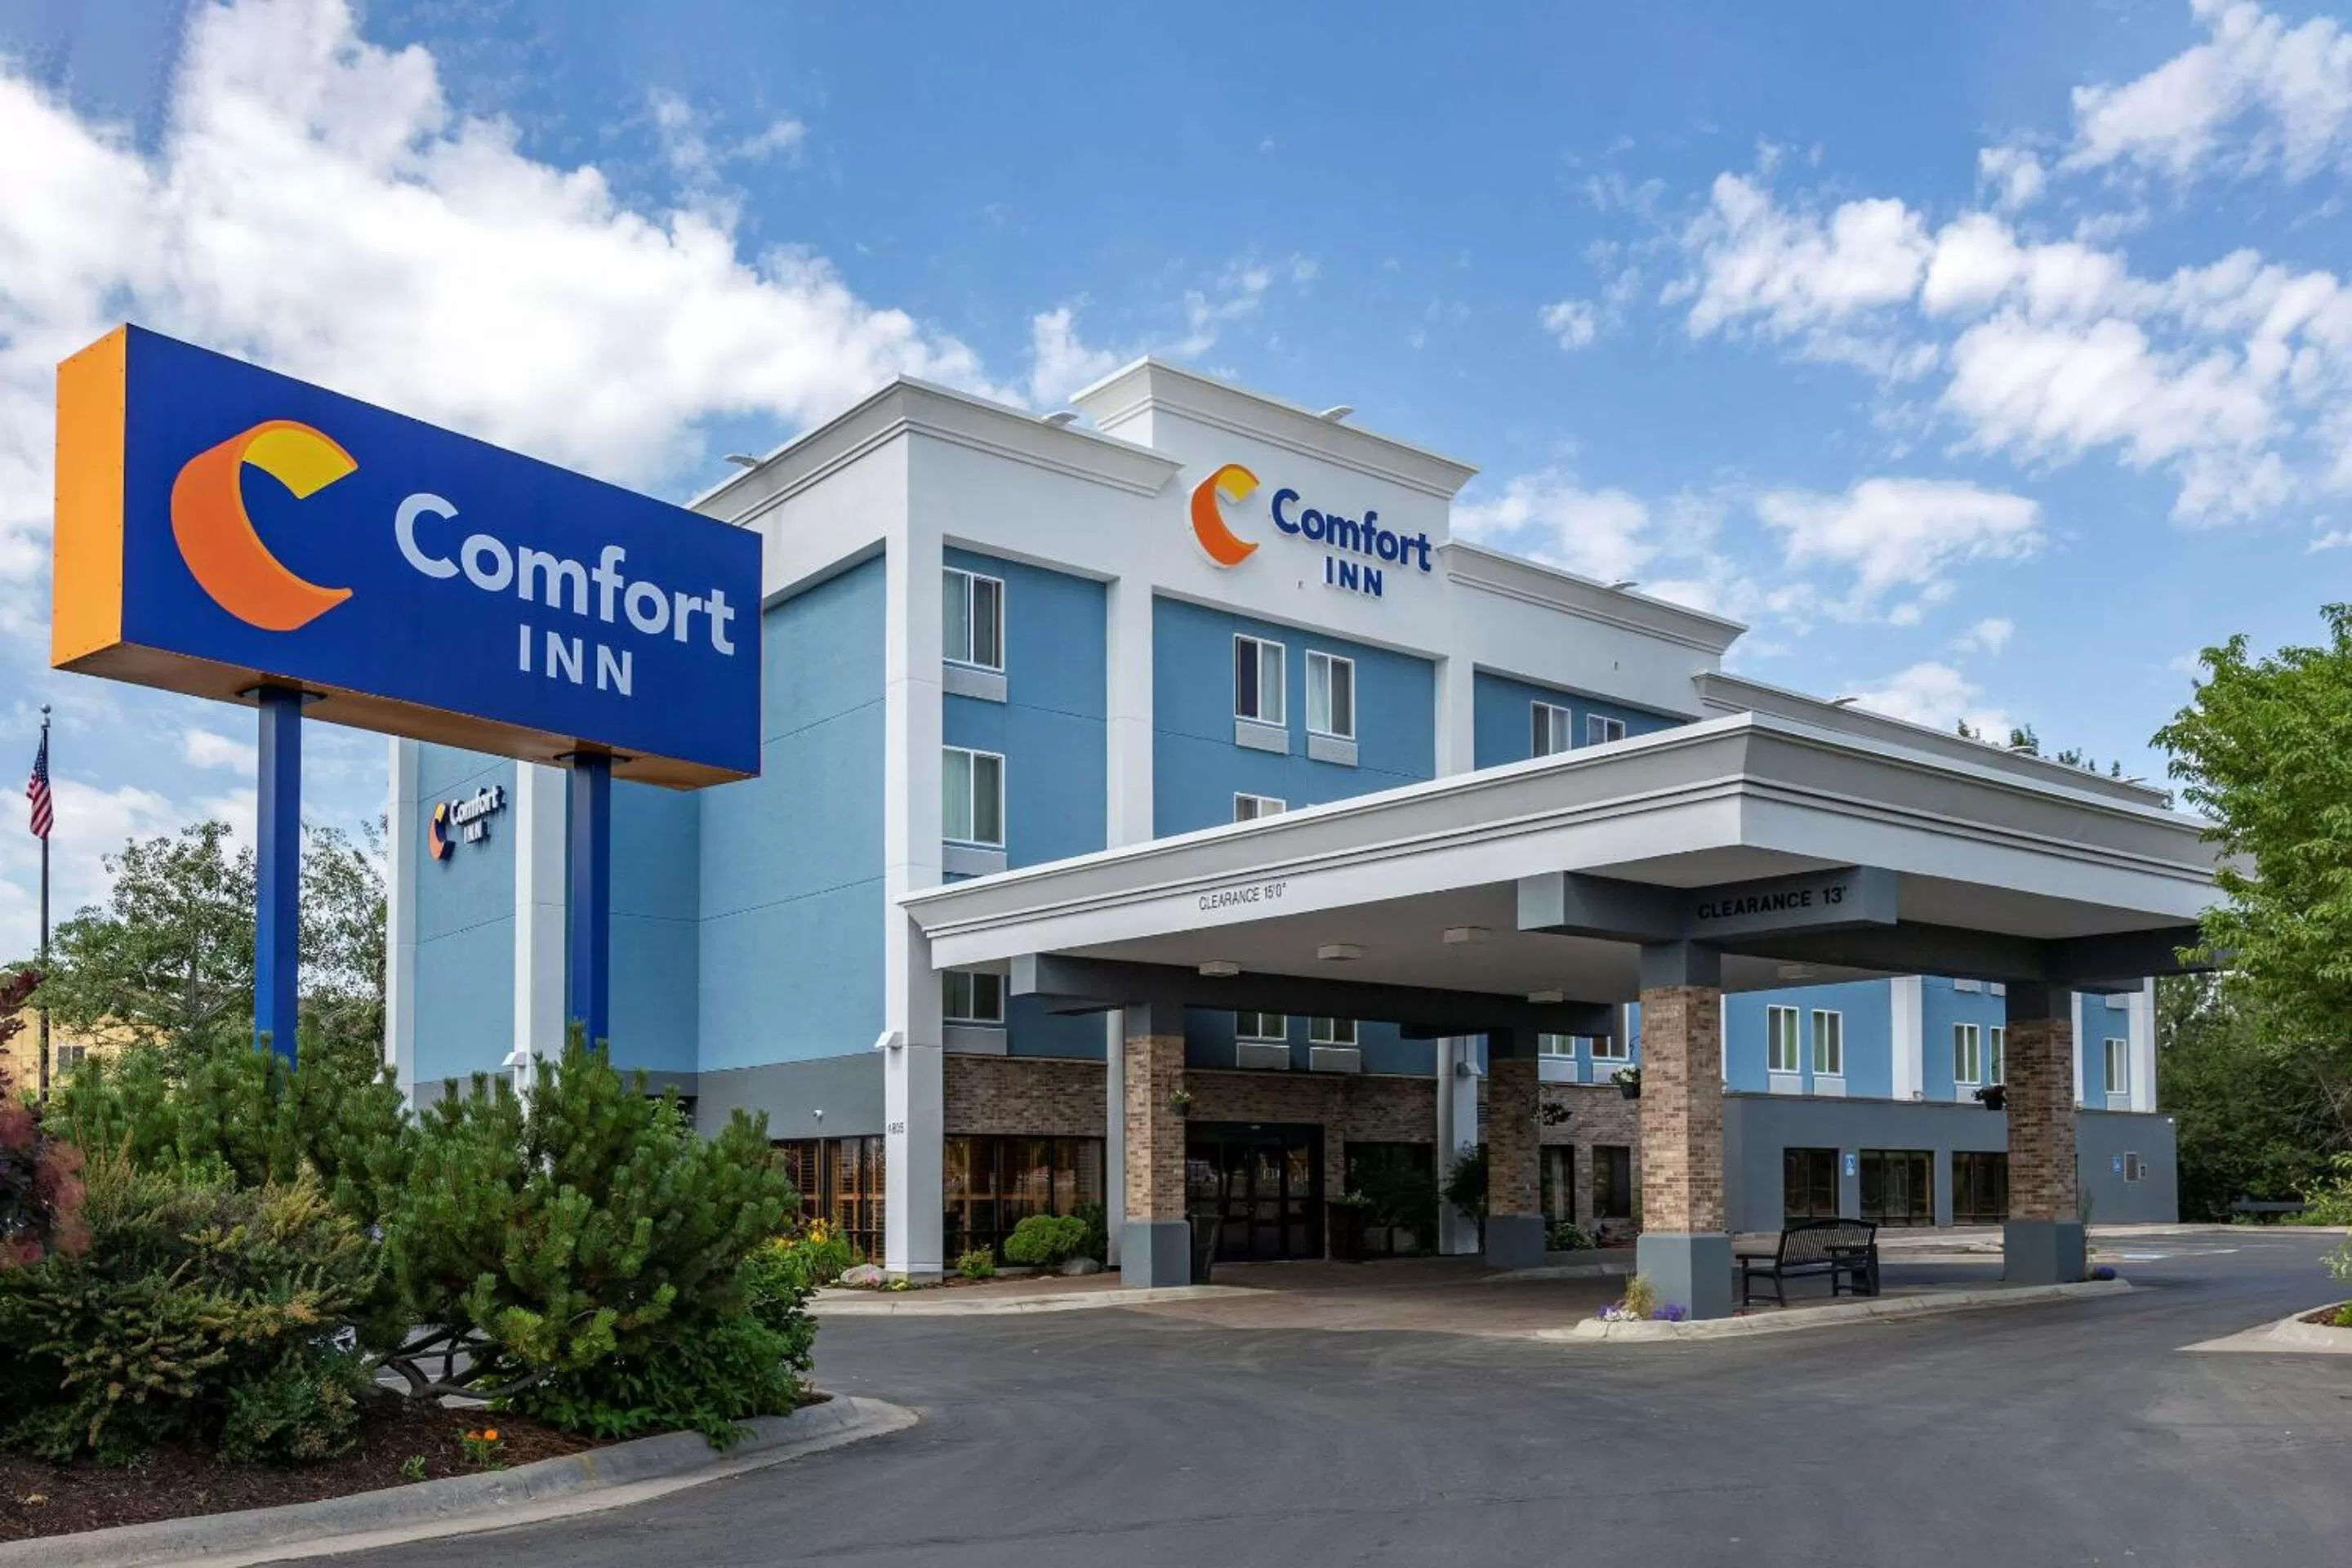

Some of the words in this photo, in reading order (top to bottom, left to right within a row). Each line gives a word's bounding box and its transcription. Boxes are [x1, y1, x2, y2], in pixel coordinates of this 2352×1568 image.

[1272, 488, 1432, 572] Comfort
[394, 492, 734, 656] Comfort
[1326, 556, 1382, 596] INN
[519, 623, 632, 697] INN
[450, 785, 502, 826] Comfort
[1199, 887, 1259, 911] CLEARANCE
[1698, 890, 1812, 920] CLEARANCE
